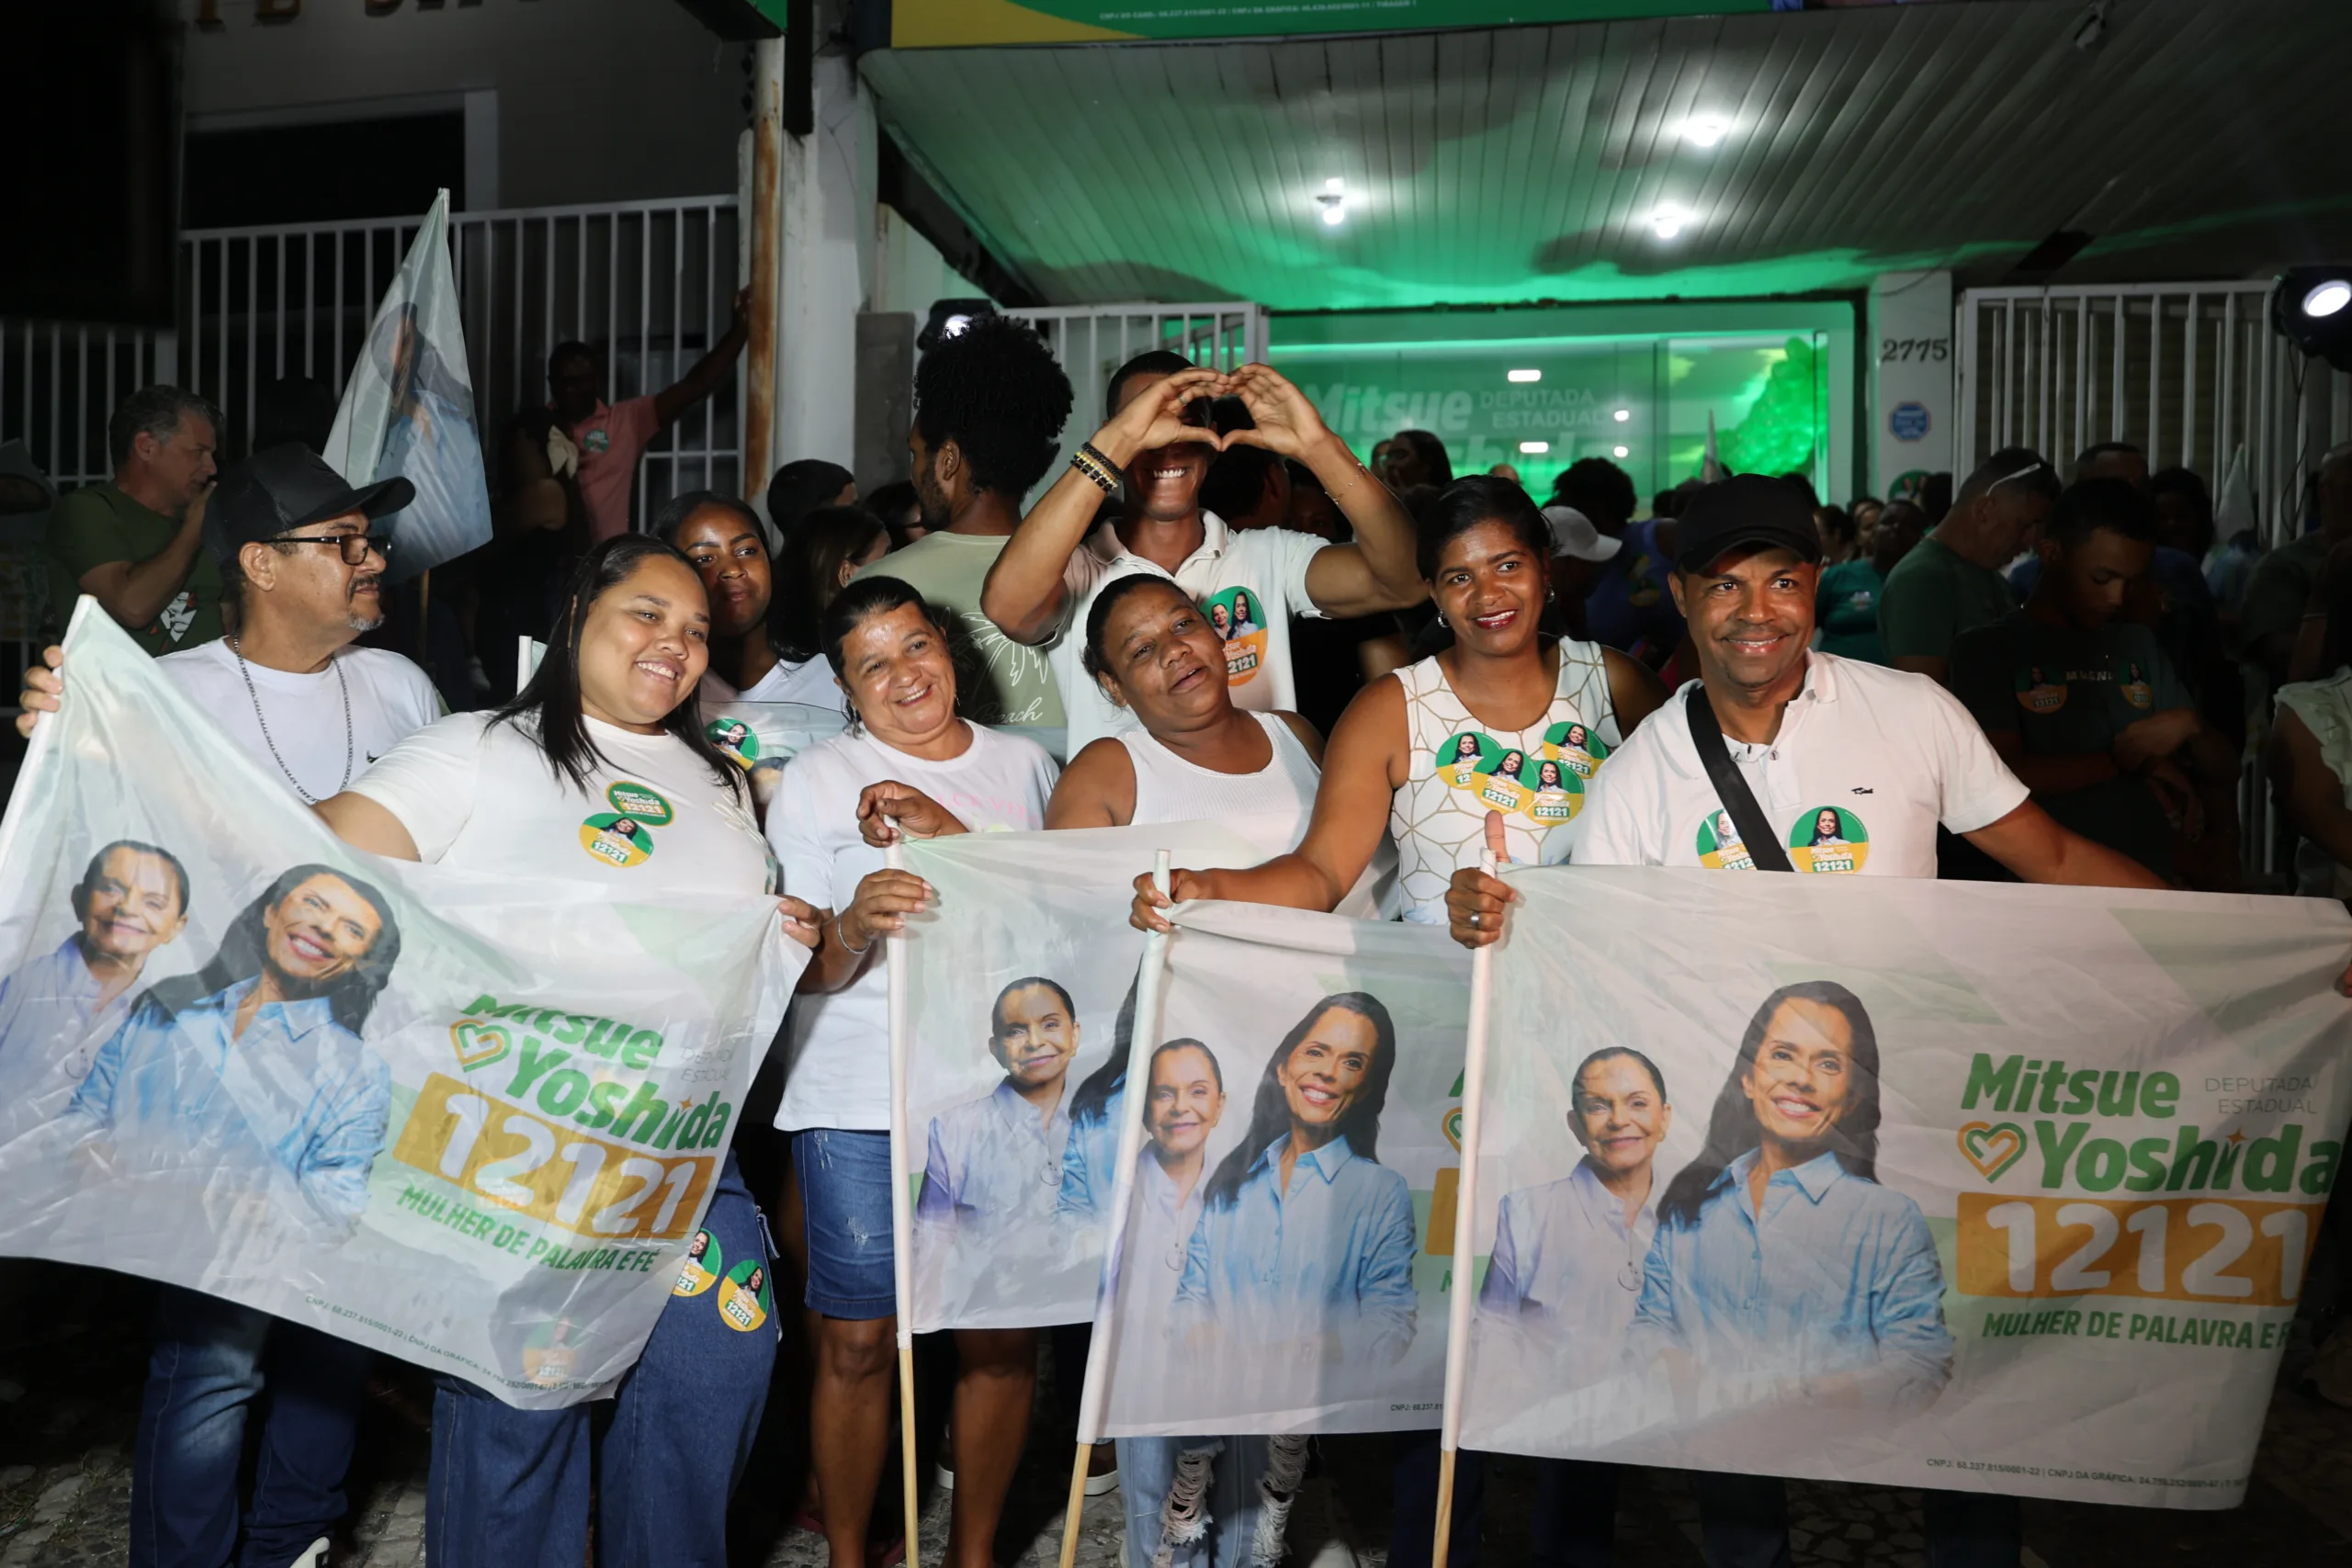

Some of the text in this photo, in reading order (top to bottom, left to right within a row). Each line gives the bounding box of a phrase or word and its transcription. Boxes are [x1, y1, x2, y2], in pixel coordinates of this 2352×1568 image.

[1882, 338, 1949, 362] 2775
[1480, 388, 1596, 410] DEPUTADA
[1492, 411, 1608, 430] ESTADUAL
[1227, 654, 1256, 673] 2121
[1485, 789, 1516, 807] 12121
[1535, 807, 1567, 817] 12121
[594, 842, 626, 862] 12121
[1814, 860, 1851, 872] 12121
[460, 994, 663, 1070] Mitsue
[505, 1034, 732, 1151] Yoshida
[1961, 1053, 2313, 1119] Mitsue DEPUTADA
[2218, 1098, 2318, 1115] ESTADUAL
[439, 1093, 696, 1235] 12121
[2033, 1120, 2342, 1195] Yoshida
[397, 1183, 497, 1242] MULHER
[493, 1224, 531, 1256] DE
[526, 1237, 616, 1271] PALAVRA
[616, 1248, 634, 1271] E
[1985, 1201, 2308, 1301] 12121
[726, 1302, 751, 1325] 12121
[1982, 1310, 2082, 1337] MULHER
[2086, 1312, 2123, 1338] DE
[2128, 1314, 2253, 1348] PALAVRA
[2259, 1321, 2276, 1349] E
[408, 1335, 429, 1351] CNPJ
[430, 1345, 442, 1356] DA
[2047, 1468, 2074, 1479] CNPJ
[2075, 1470, 2089, 1480] DA
